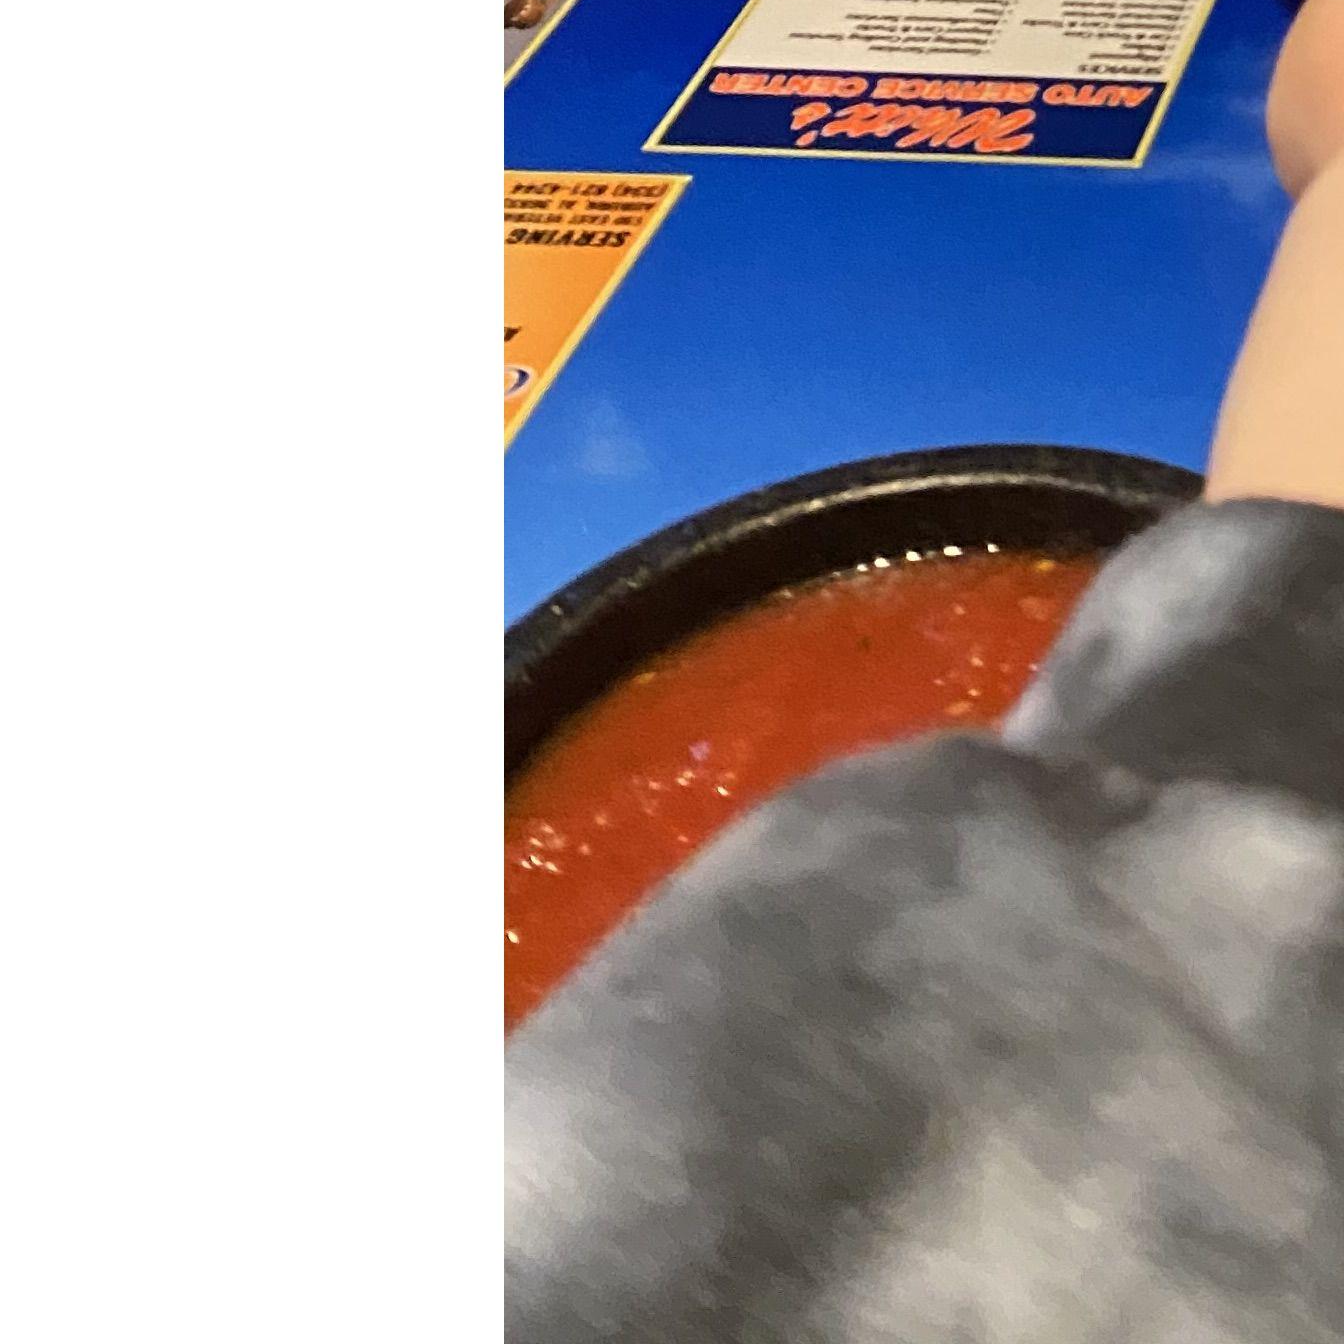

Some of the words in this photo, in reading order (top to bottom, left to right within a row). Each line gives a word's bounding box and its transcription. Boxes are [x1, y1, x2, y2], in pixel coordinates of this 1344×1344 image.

[708, 72, 869, 98] CENTER
[870, 78, 1040, 104] SERVICE
[1042, 83, 1154, 108] AUTO
[506, 228, 632, 248] SERVING
